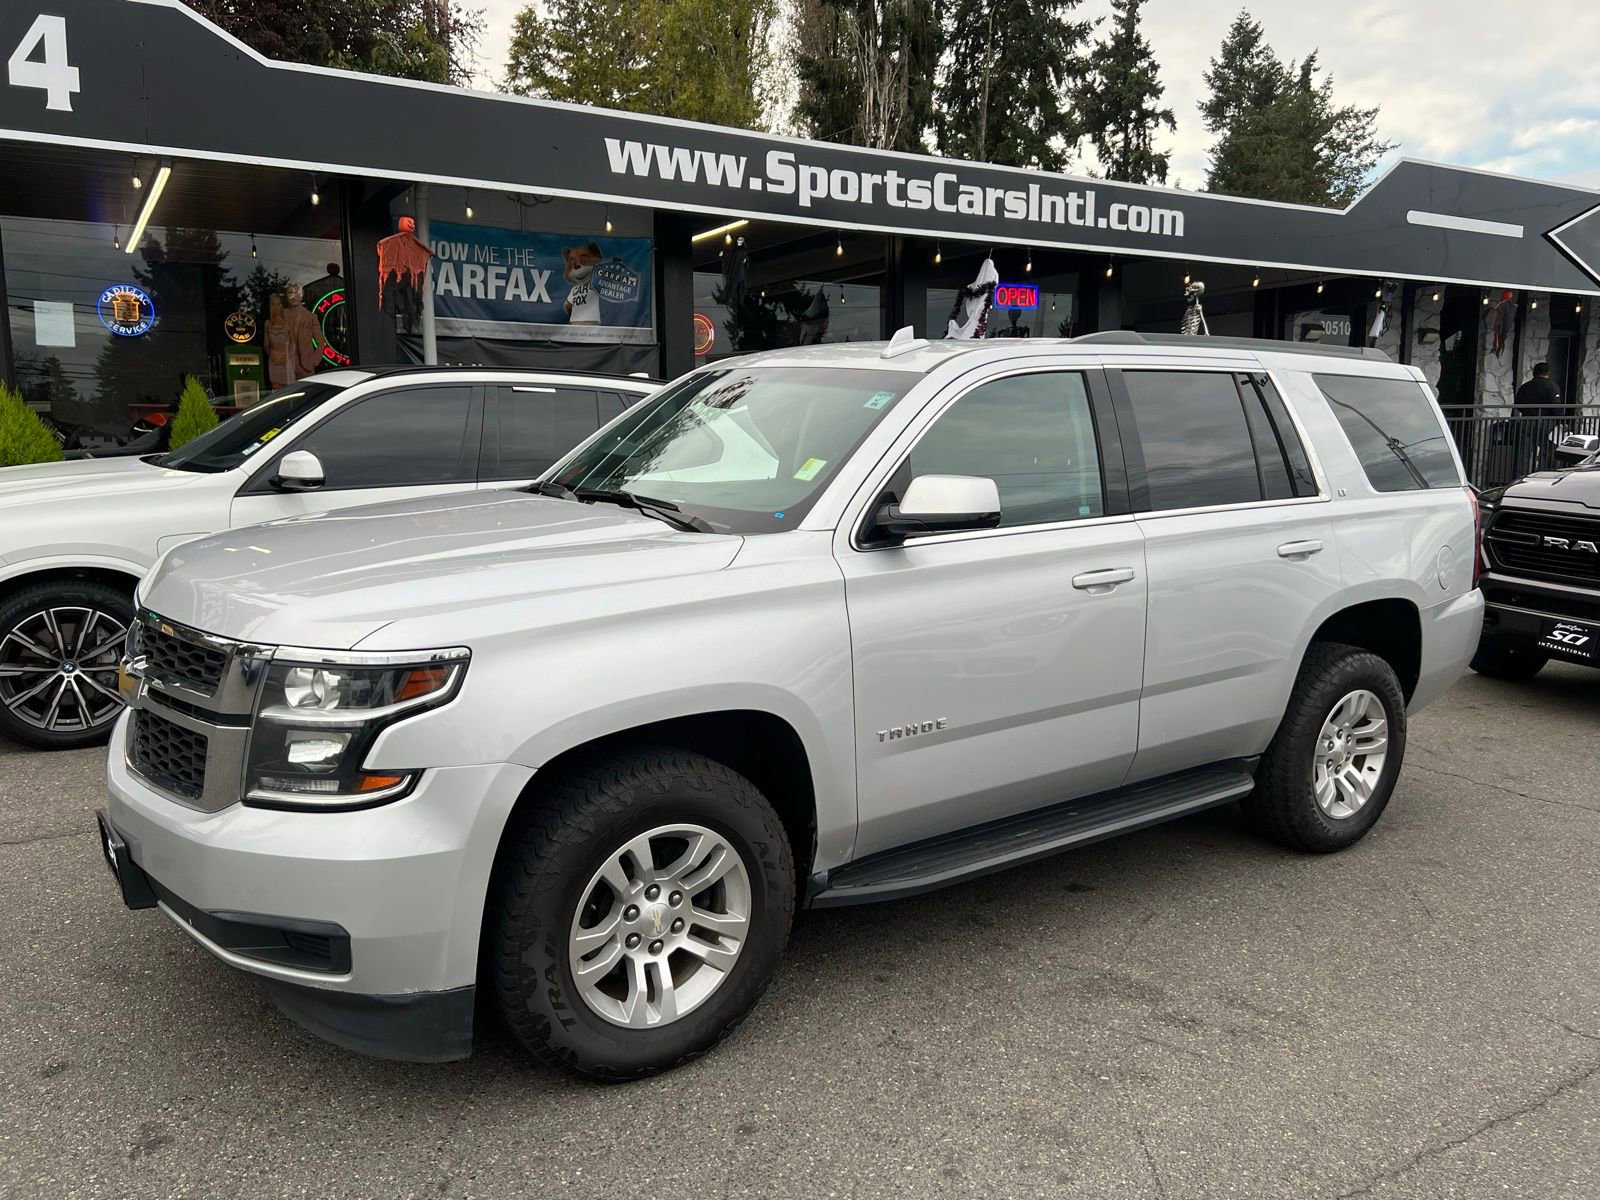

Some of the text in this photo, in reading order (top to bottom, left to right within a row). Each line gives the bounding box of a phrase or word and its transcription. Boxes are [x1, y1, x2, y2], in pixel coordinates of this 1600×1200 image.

[8, 14, 80, 112] 4
[604, 136, 1185, 237] www.SportsCarsIntl.com
[475, 245, 500, 264] ME
[504, 247, 536, 267] THE
[431, 261, 552, 303] ARFAX
[598, 269, 637, 287] CARFAX
[598, 279, 632, 294] ADVANTAGE
[102, 286, 150, 306] CADILLAC
[572, 283, 592, 297] CAR
[572, 294, 588, 306] FOX
[601, 287, 625, 300] DEALER
[997, 287, 1036, 307] OPEN
[108, 320, 148, 334] SERVICE
[876, 717, 948, 742] TAHOE
